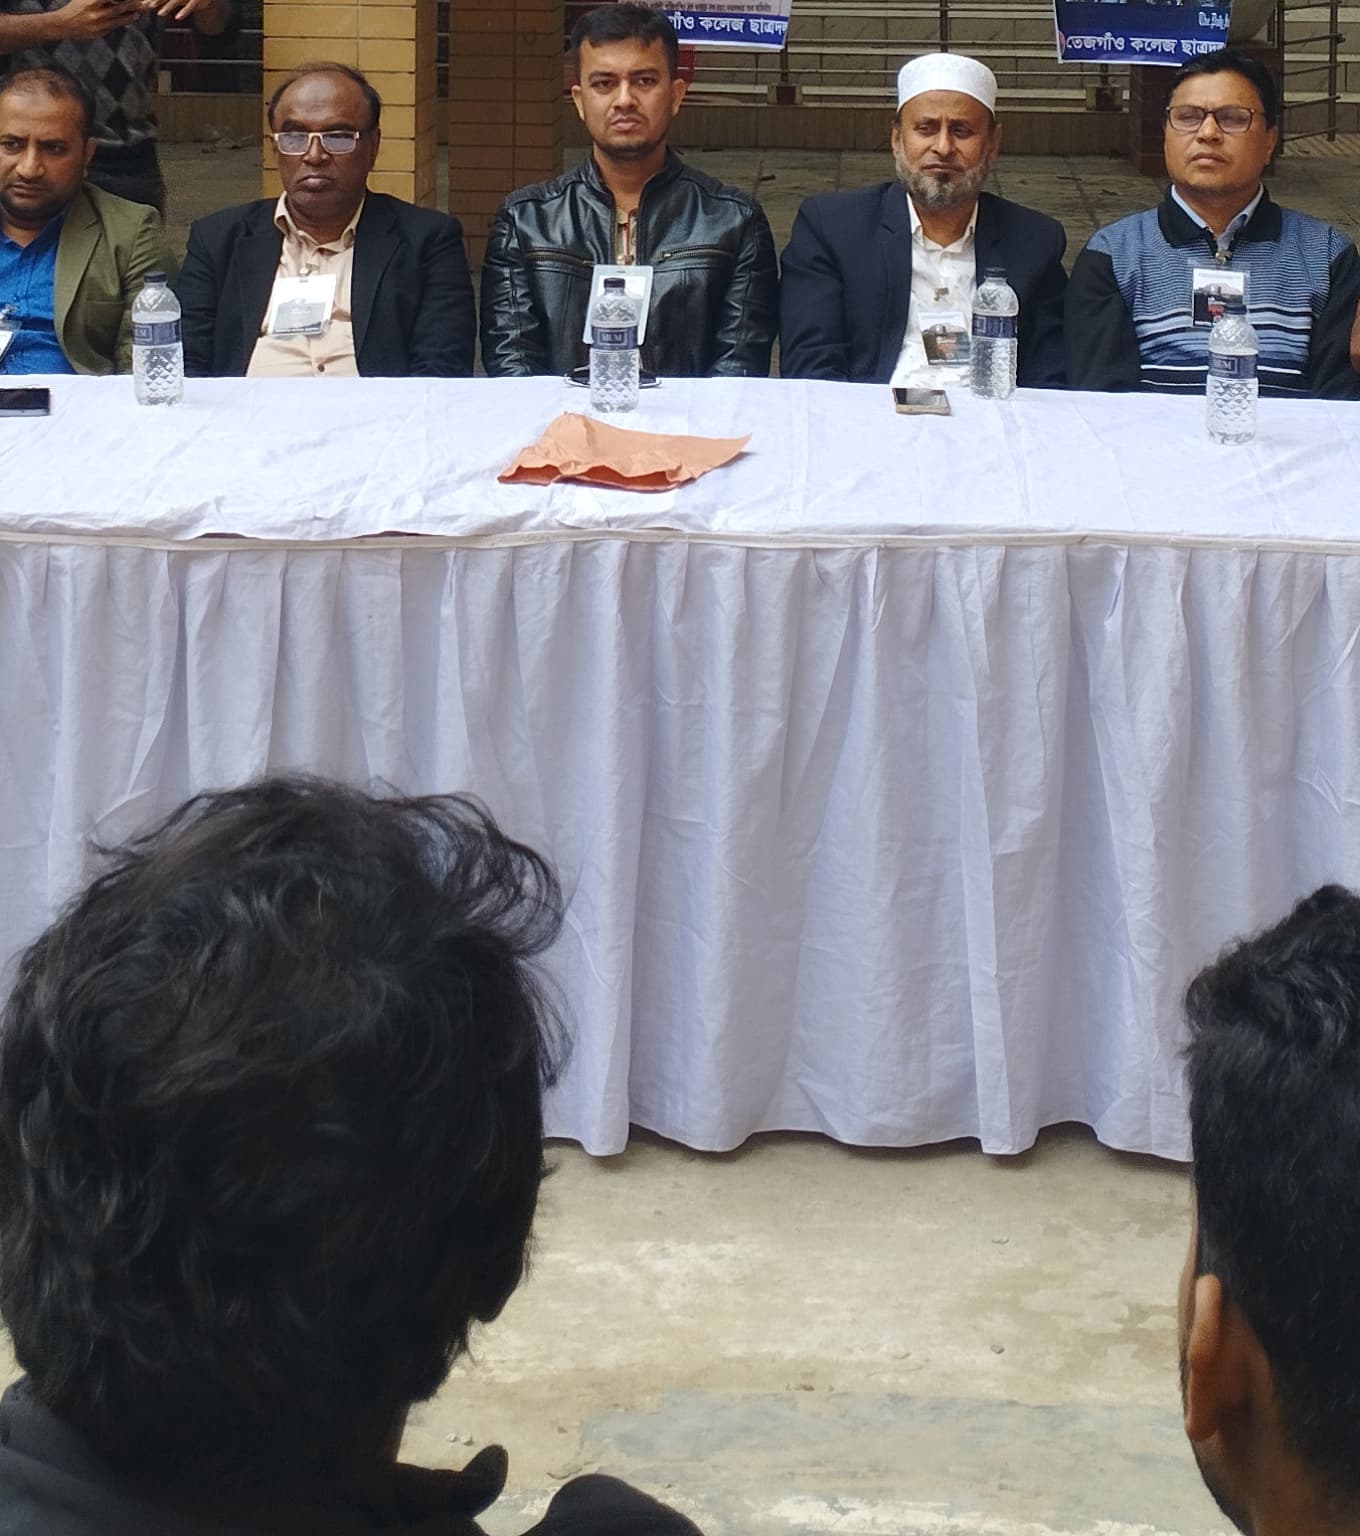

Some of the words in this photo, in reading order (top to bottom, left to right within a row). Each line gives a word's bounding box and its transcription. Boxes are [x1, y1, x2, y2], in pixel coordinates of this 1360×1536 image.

[700, 16, 744, 33] কলেজ
[1066, 32, 1125, 52] তেজগাঁও
[1130, 38, 1175, 54] কলেজ
